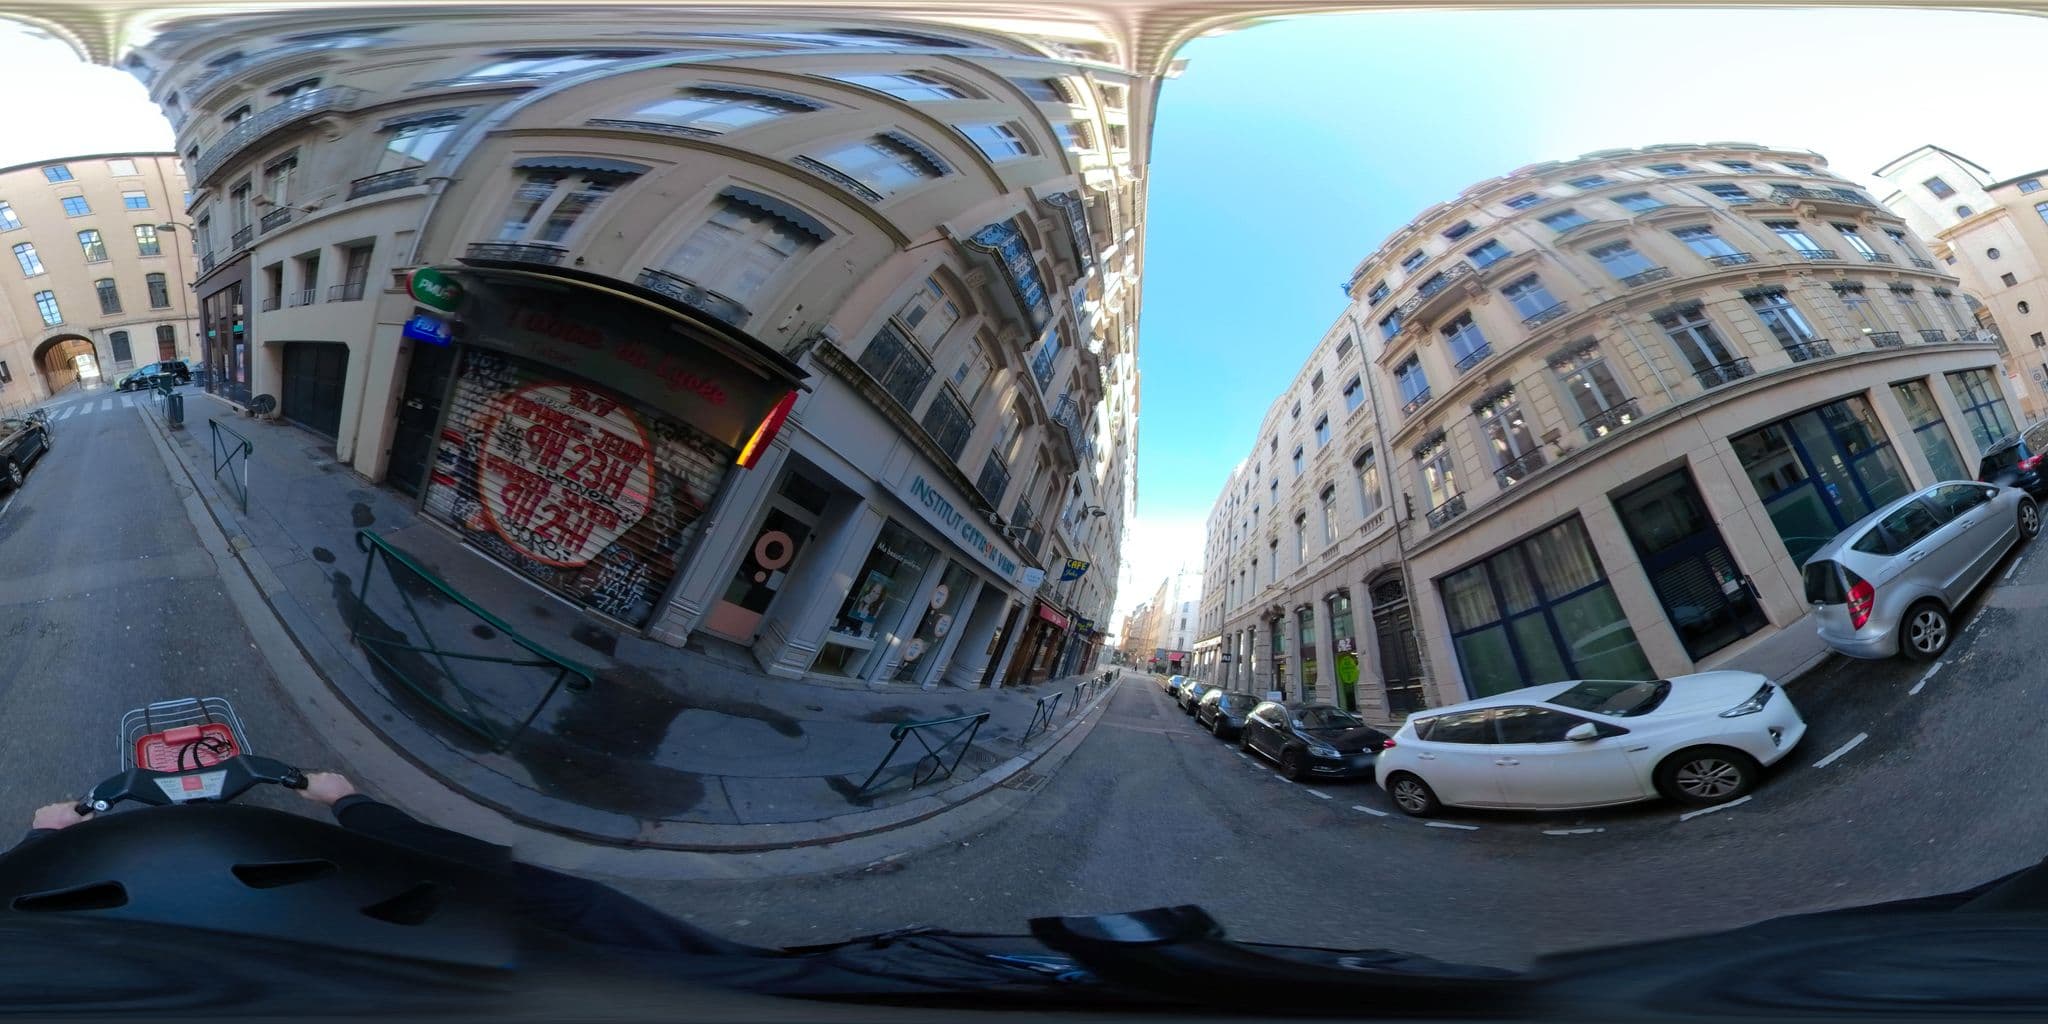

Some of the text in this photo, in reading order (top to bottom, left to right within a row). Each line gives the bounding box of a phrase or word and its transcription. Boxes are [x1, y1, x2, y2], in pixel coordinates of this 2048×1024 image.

[418, 279, 449, 298] PMU
[910, 475, 964, 530] INSTITUT
[962, 523, 998, 562] CITRON
